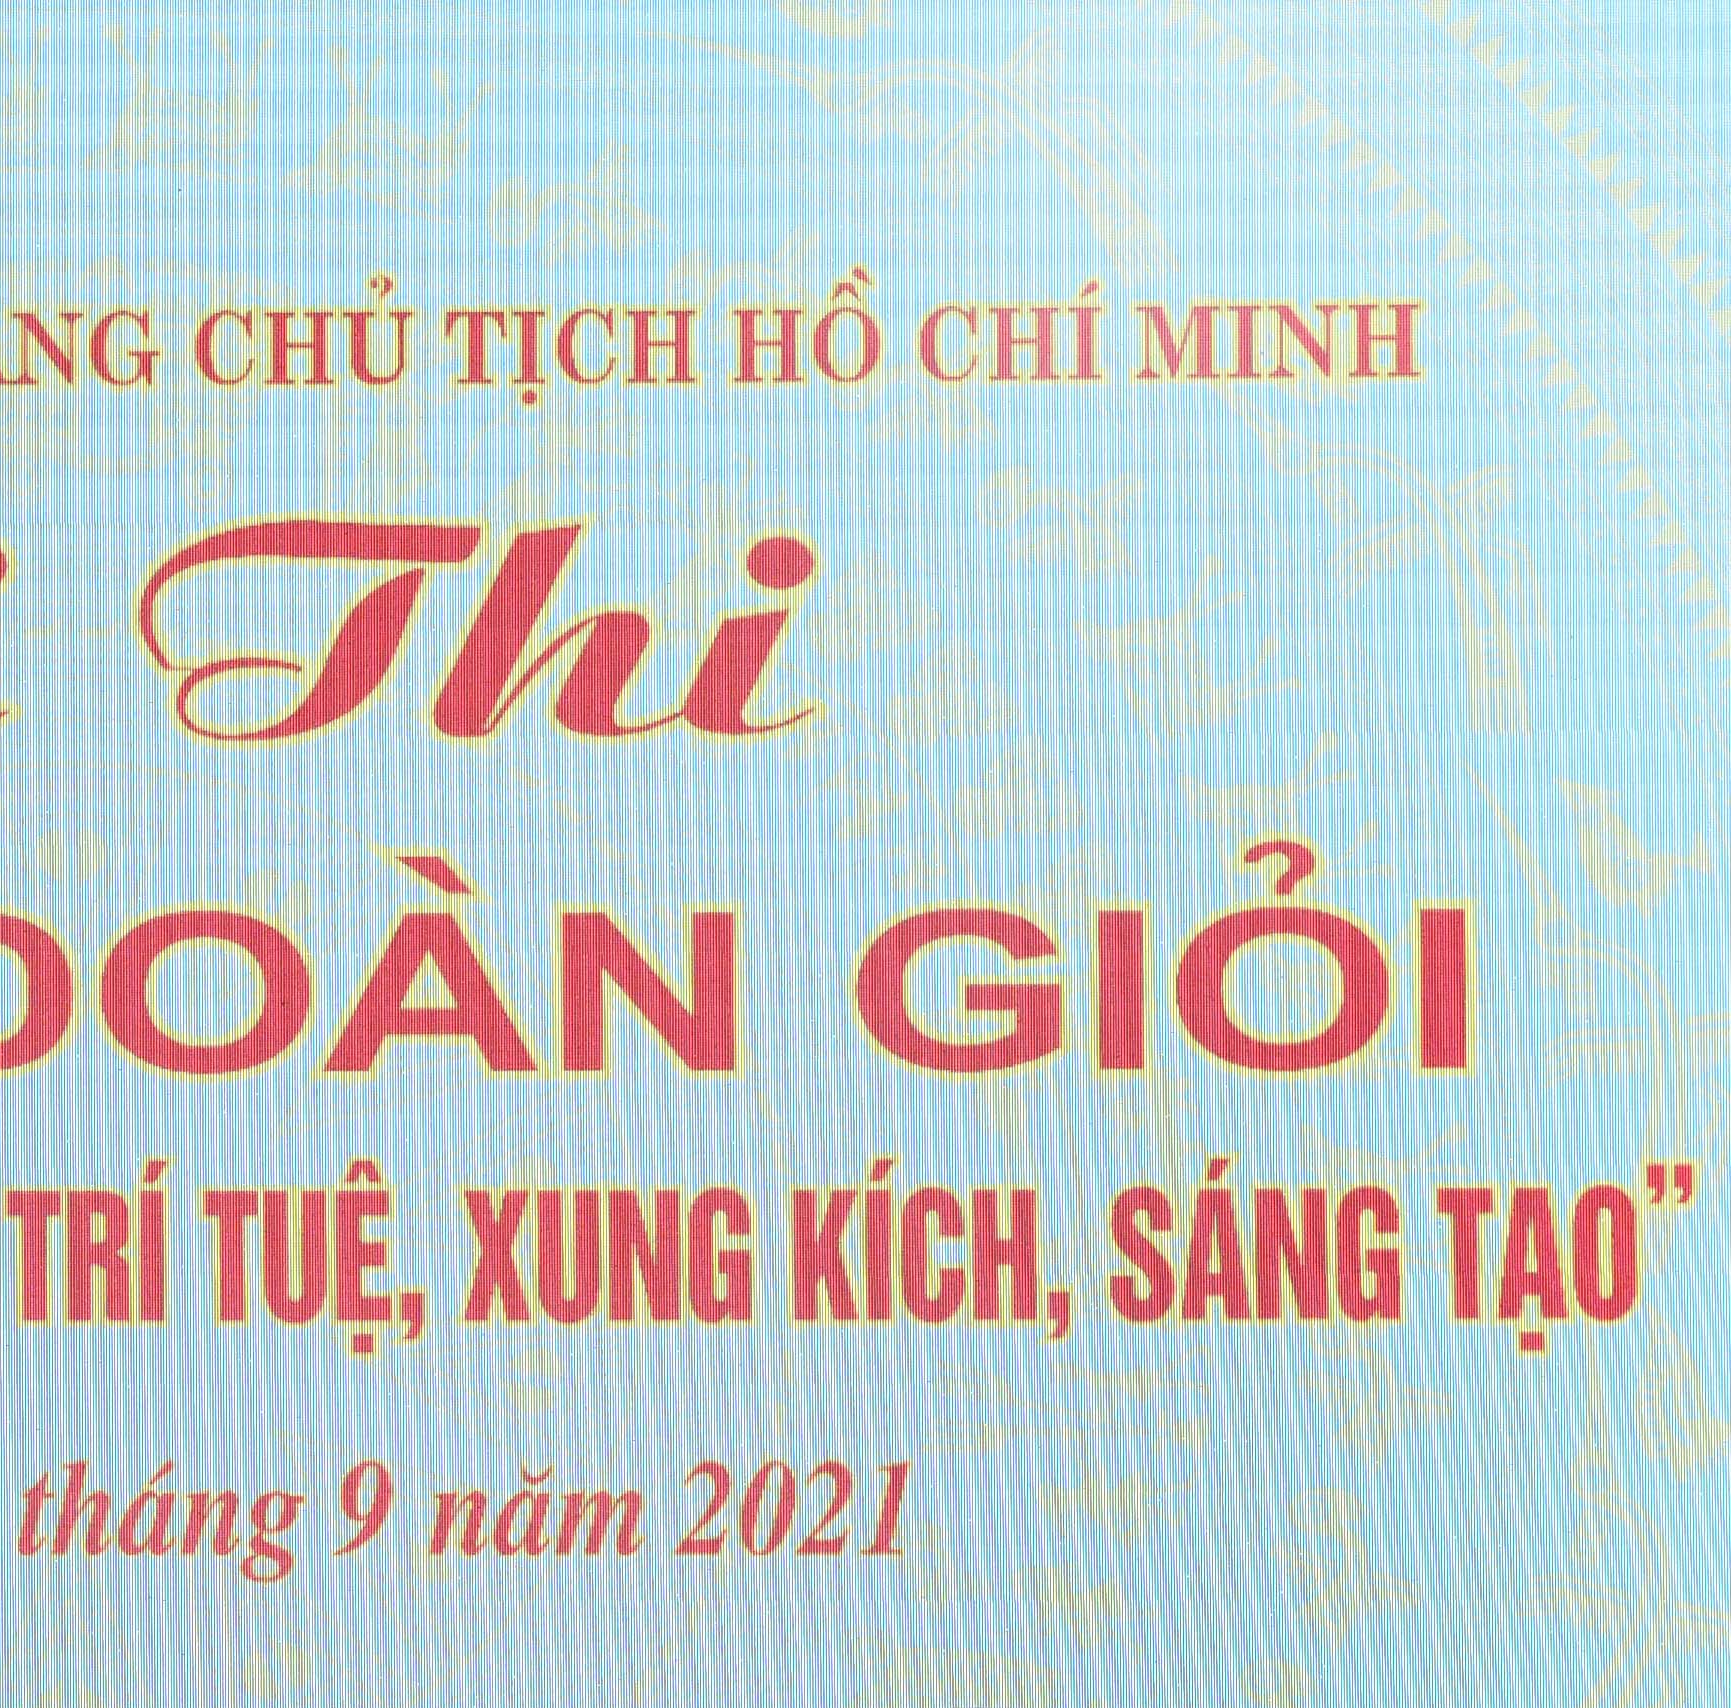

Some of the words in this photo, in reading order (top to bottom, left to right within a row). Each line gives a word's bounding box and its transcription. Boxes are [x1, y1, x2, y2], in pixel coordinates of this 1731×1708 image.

[194, 274, 414, 386] CHỦ
[443, 308, 697, 404] TỊCH
[732, 267, 881, 384] HỒ
[918, 280, 1104, 382] CHÍ
[1136, 302, 1423, 380] MINH
[138, 518, 819, 742] Thi
[855, 839, 1471, 1074] GIỎI
[5, 1160, 167, 1323] TRÍ
[203, 1160, 426, 1355] TUỆ,
[462, 1187, 754, 1325] XUNG
[792, 1158, 1073, 1340] KÍCH,
[1109, 1158, 1402, 1324] SÁNG
[16, 1460, 306, 1582] tháng
[338, 1460, 395, 1555] 9
[428, 1474, 644, 1556] năm
[676, 1460, 915, 1556] 2021
